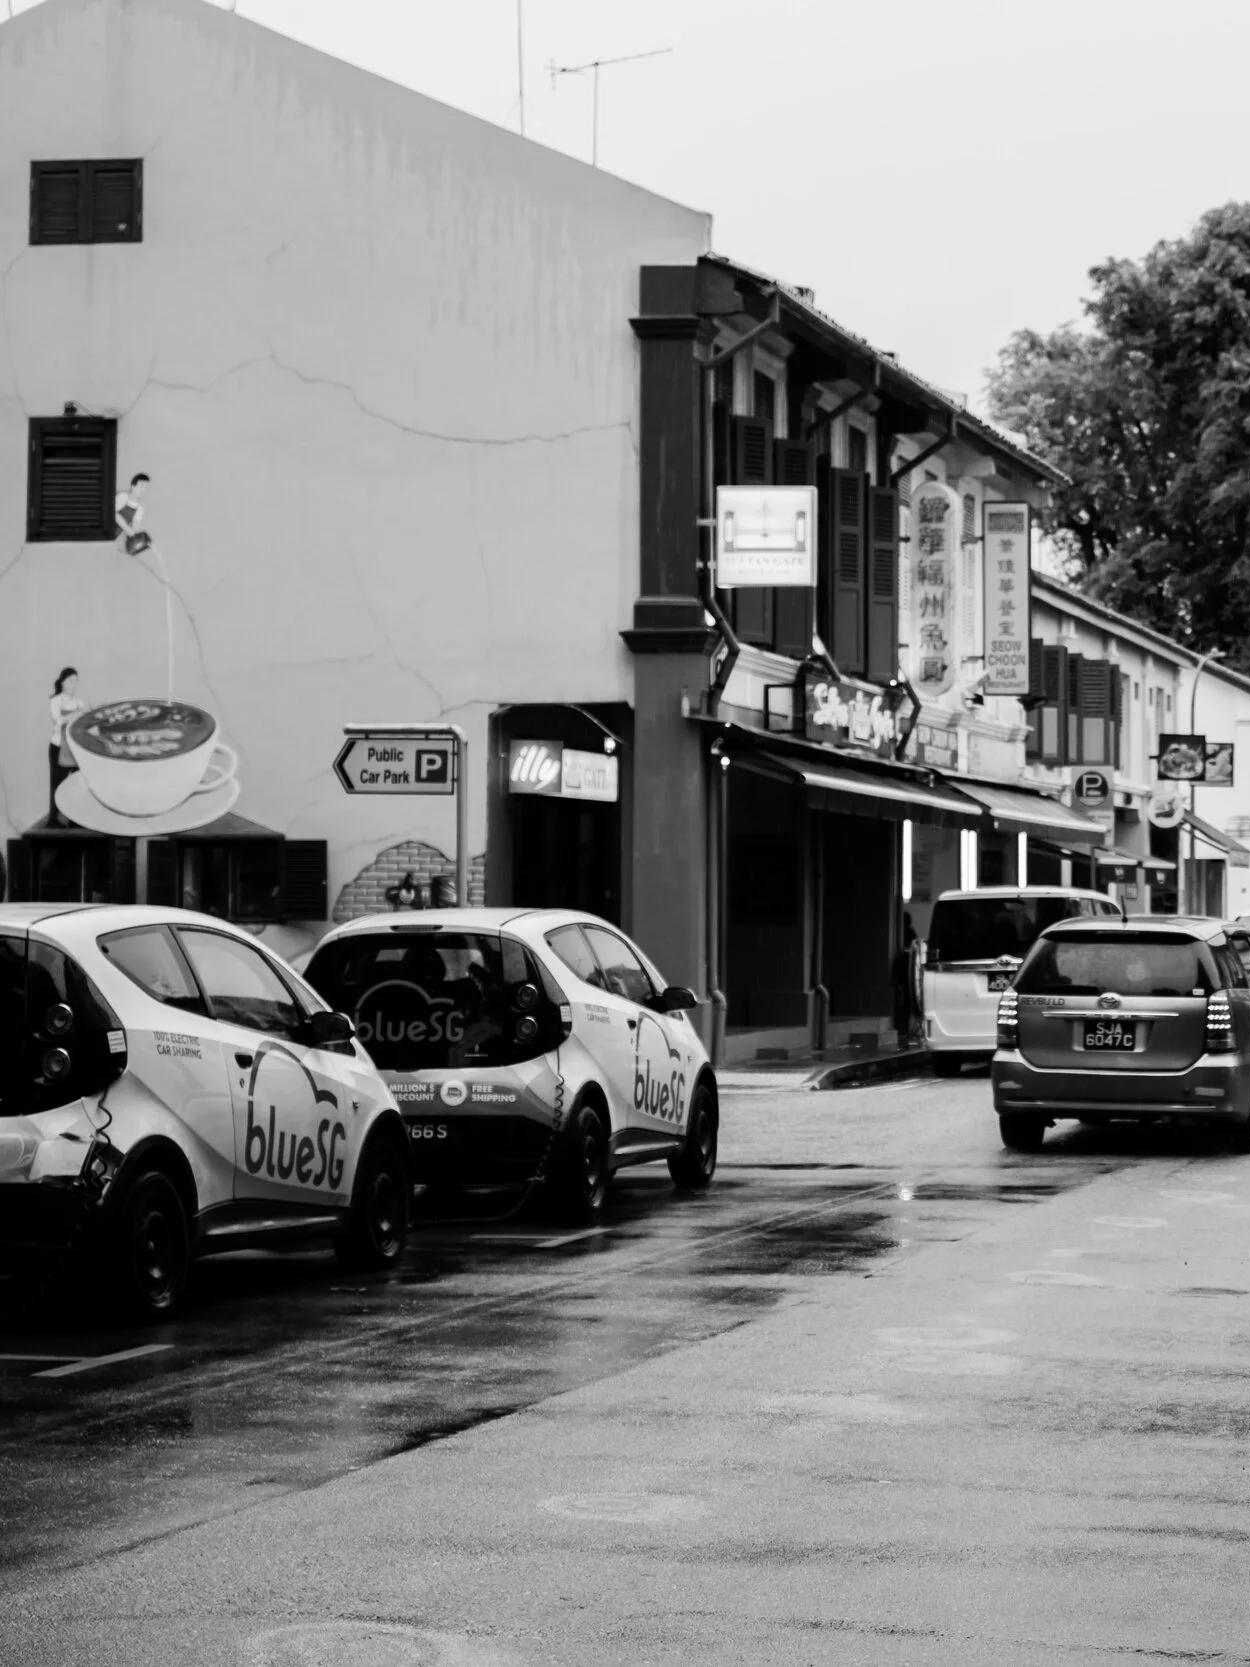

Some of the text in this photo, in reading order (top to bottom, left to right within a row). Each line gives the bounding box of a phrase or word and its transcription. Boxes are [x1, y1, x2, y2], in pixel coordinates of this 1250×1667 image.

[991, 640, 1022, 653] SEOW
[987, 654, 1026, 667] CHOON
[995, 668, 1017, 680] HUA
[367, 747, 404, 762] Public
[420, 753, 442, 779] P
[510, 744, 561, 791] illy
[359, 769, 410, 784] Car Park
[354, 1011, 465, 1043] blueSG
[1096, 1023, 1122, 1035] SJA
[1086, 1034, 1133, 1047] 6047C
[156, 1044, 202, 1060] CAR SHARING
[472, 1085, 494, 1093] FREE
[634, 1055, 685, 1124] blueSG
[471, 1094, 516, 1103] SHIPPING
[244, 1100, 346, 1190] blueSG
